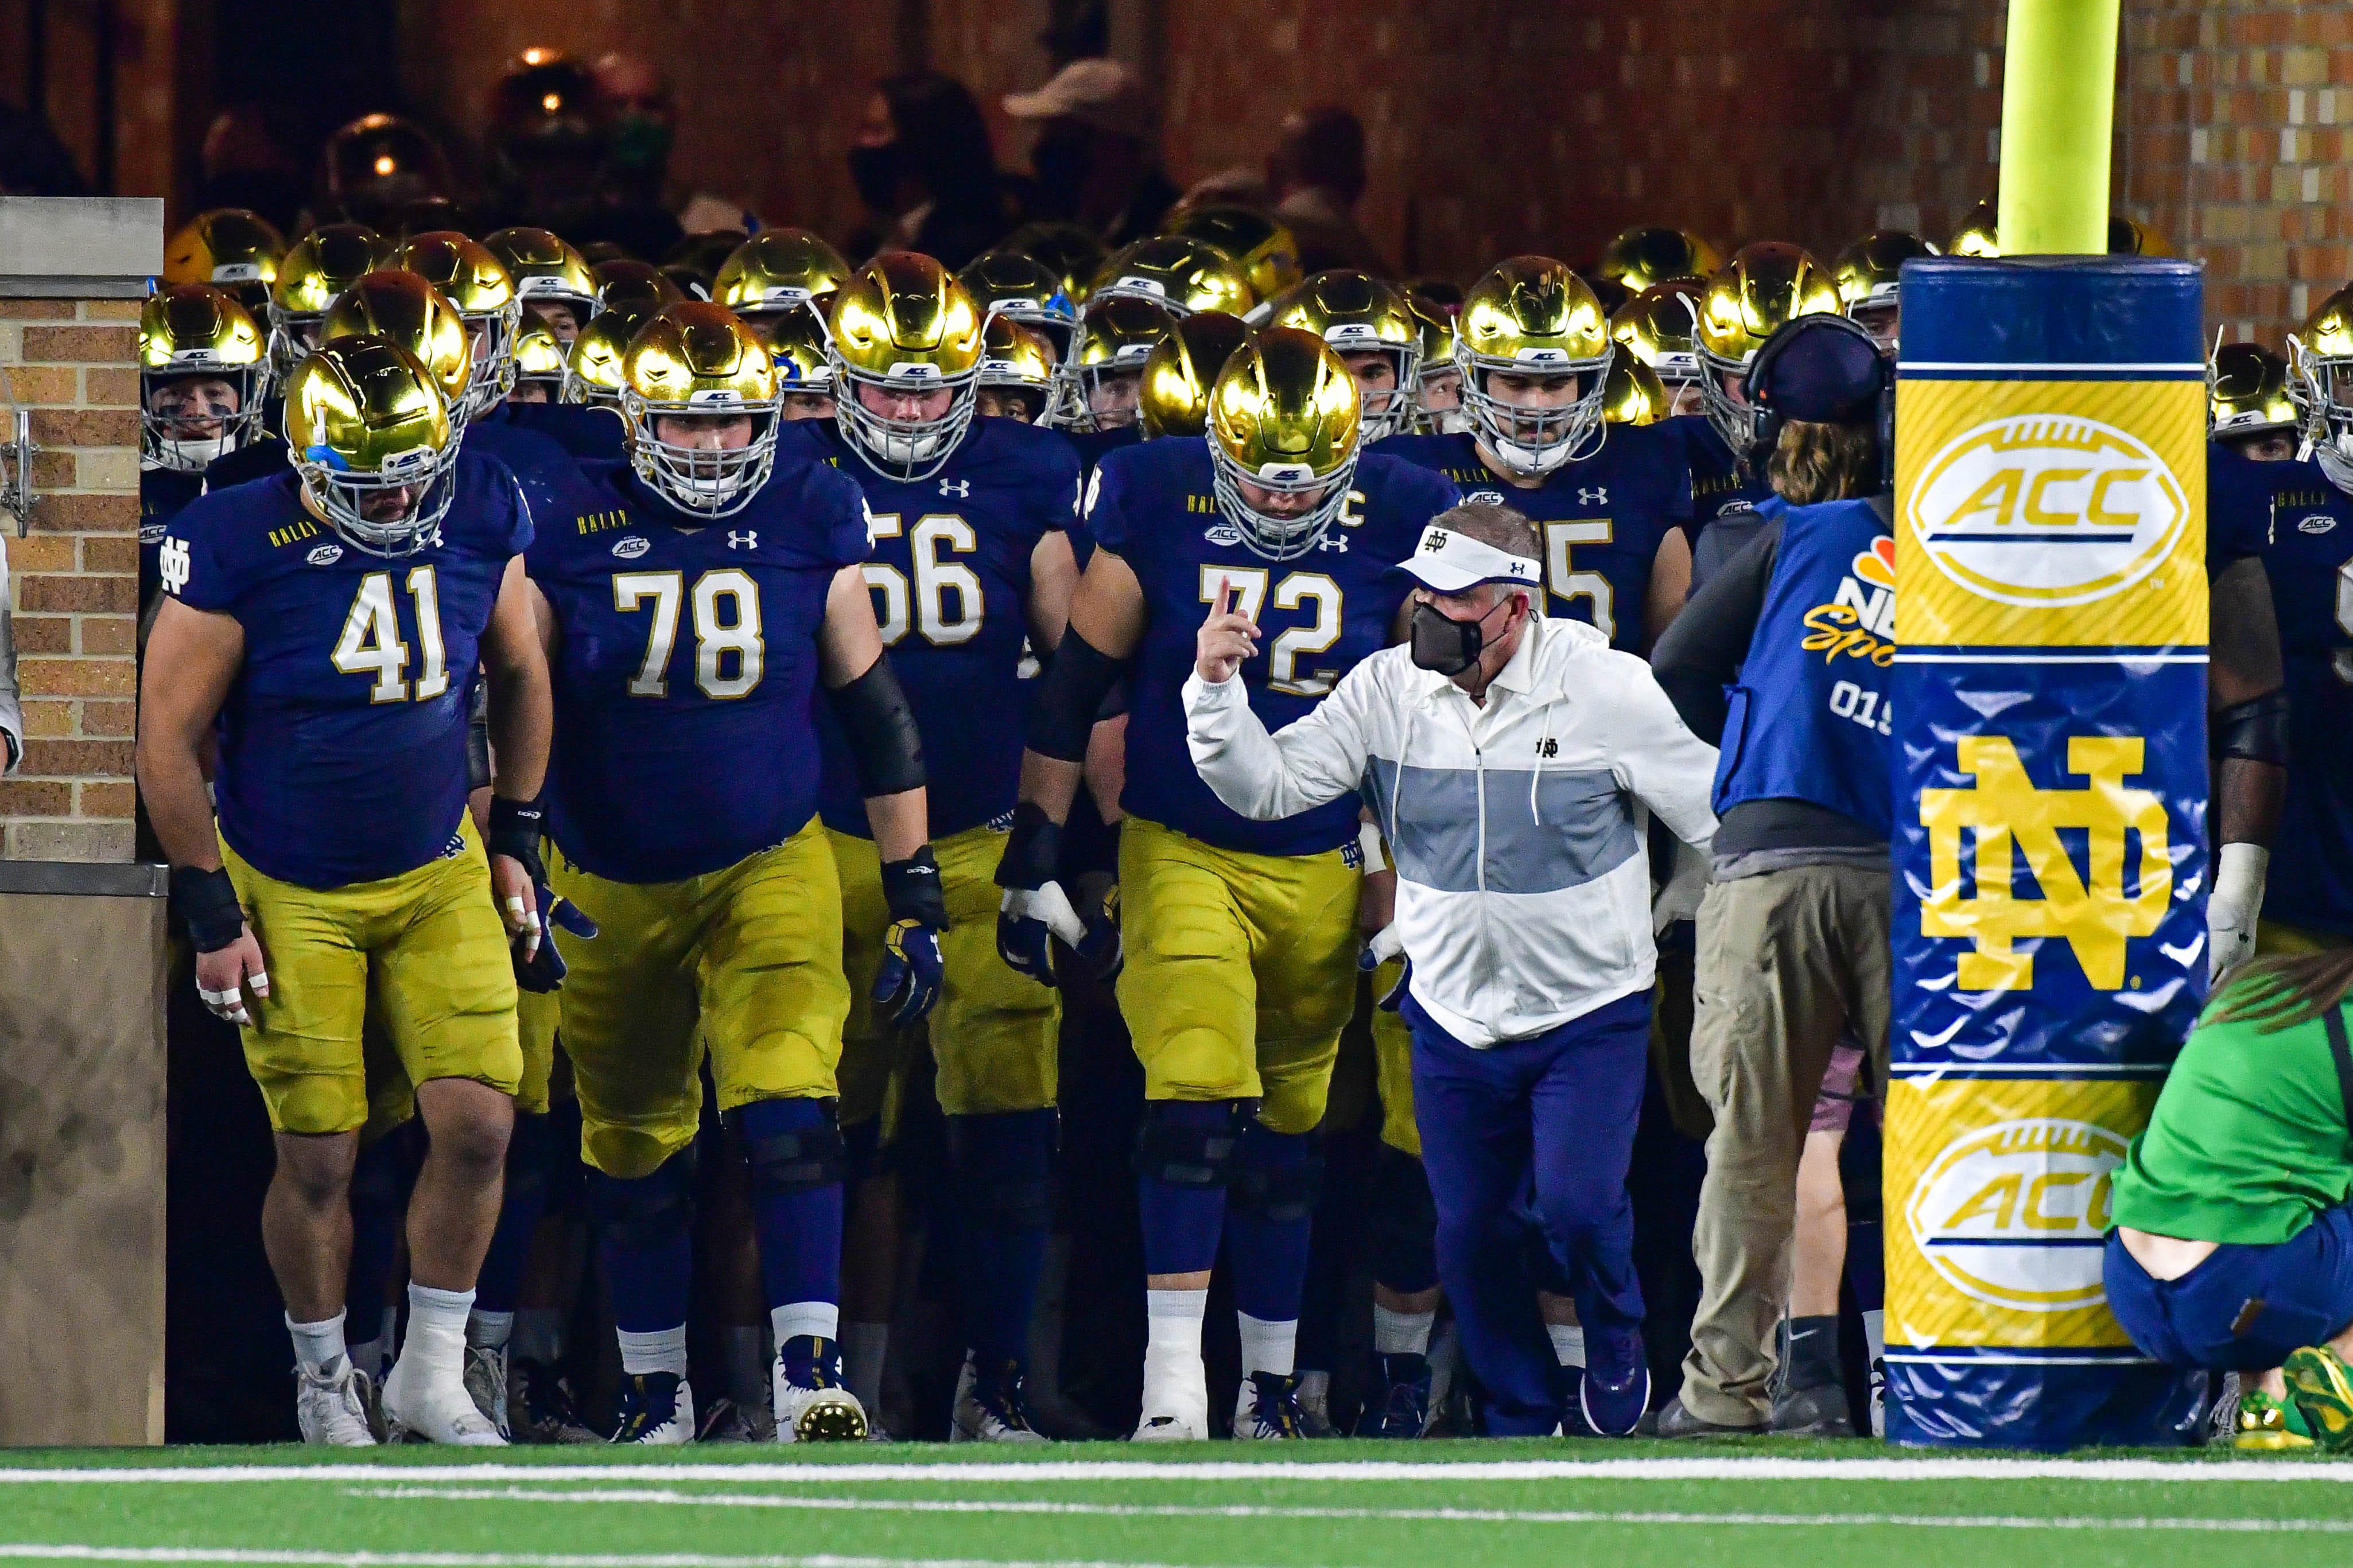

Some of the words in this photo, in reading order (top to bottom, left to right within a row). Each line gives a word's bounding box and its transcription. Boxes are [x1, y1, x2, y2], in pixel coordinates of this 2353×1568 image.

[1471, 493, 1498, 503] ACC
[1943, 469, 2152, 526] ACC
[2304, 519, 2331, 527] ACC
[312, 546, 339, 561] ACC
[616, 539, 645, 552] ACC
[1209, 529, 1237, 538] ACC
[861, 513, 984, 647] 56
[1529, 519, 1617, 636] 5
[331, 564, 449, 705] 41
[612, 568, 764, 699] 78
[1199, 563, 1344, 697] 72
